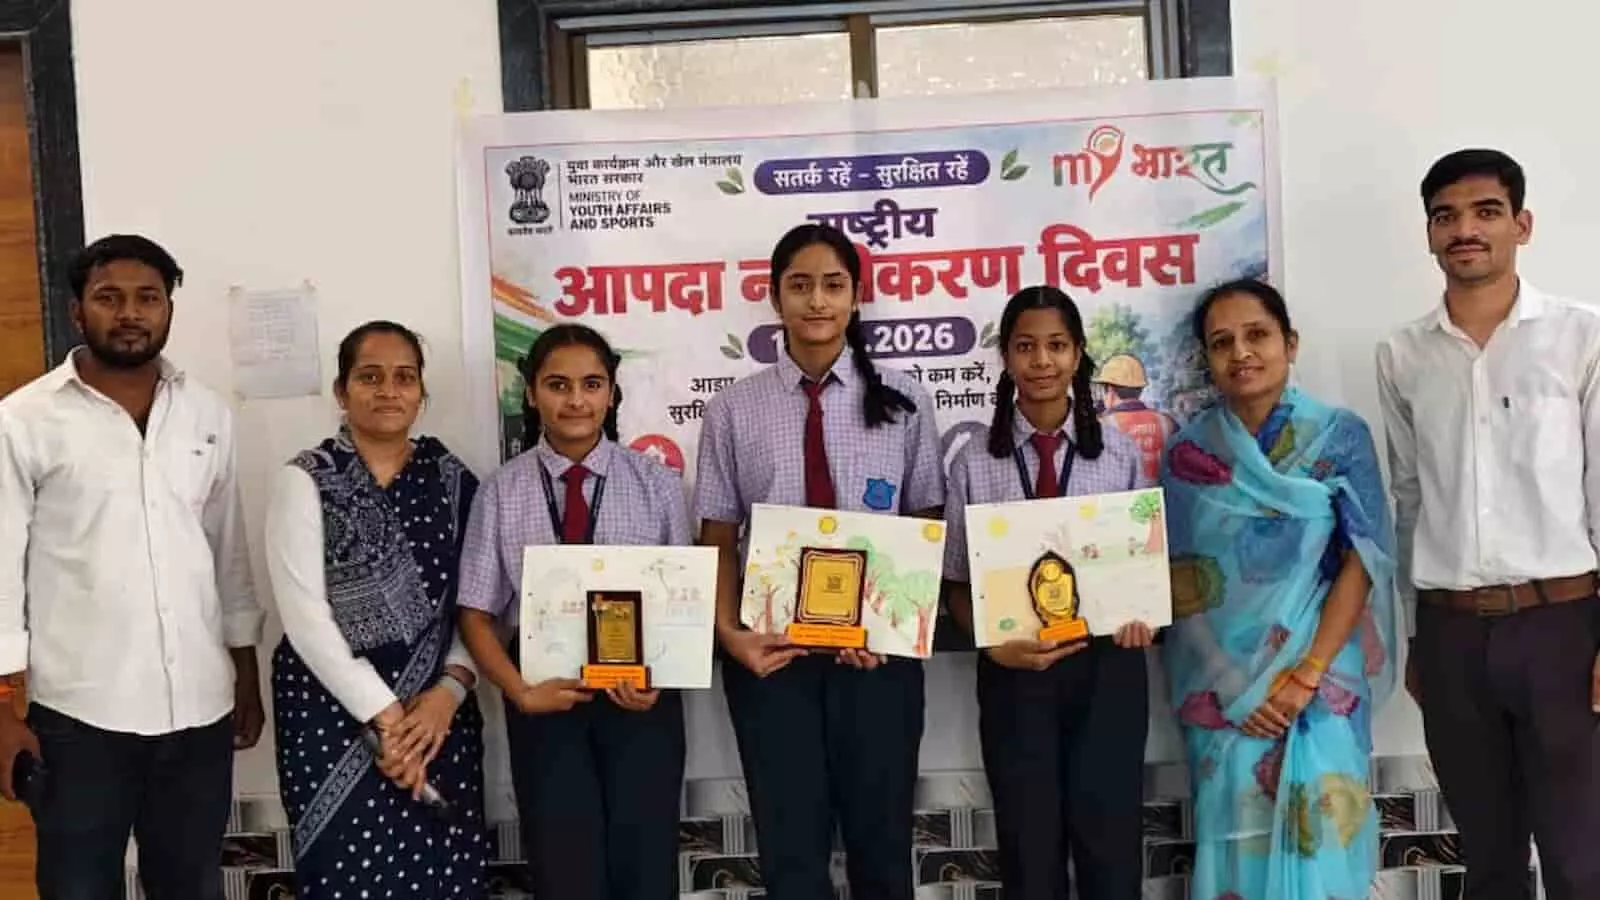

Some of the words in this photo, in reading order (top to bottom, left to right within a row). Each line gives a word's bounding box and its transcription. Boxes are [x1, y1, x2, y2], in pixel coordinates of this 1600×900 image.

[644, 153, 667, 169] और
[1131, 143, 1257, 195] भारत
[773, 160, 823, 188] सतर्क
[828, 160, 853, 187] रहें
[875, 156, 941, 188] सुरक्षित
[945, 153, 970, 179] रहें
[567, 174, 599, 186] भारत
[568, 191, 622, 203] MINISTRY
[625, 190, 641, 202] OF
[569, 203, 613, 217] YOUTH
[616, 201, 672, 215] AFFAIRS
[570, 217, 598, 231] AND
[600, 215, 655, 230] SPORTS
[553, 261, 726, 317] आपदा
[1037, 224, 1201, 294] दिवस
[927, 368, 956, 385] कम
[935, 387, 985, 409] निर्माण
